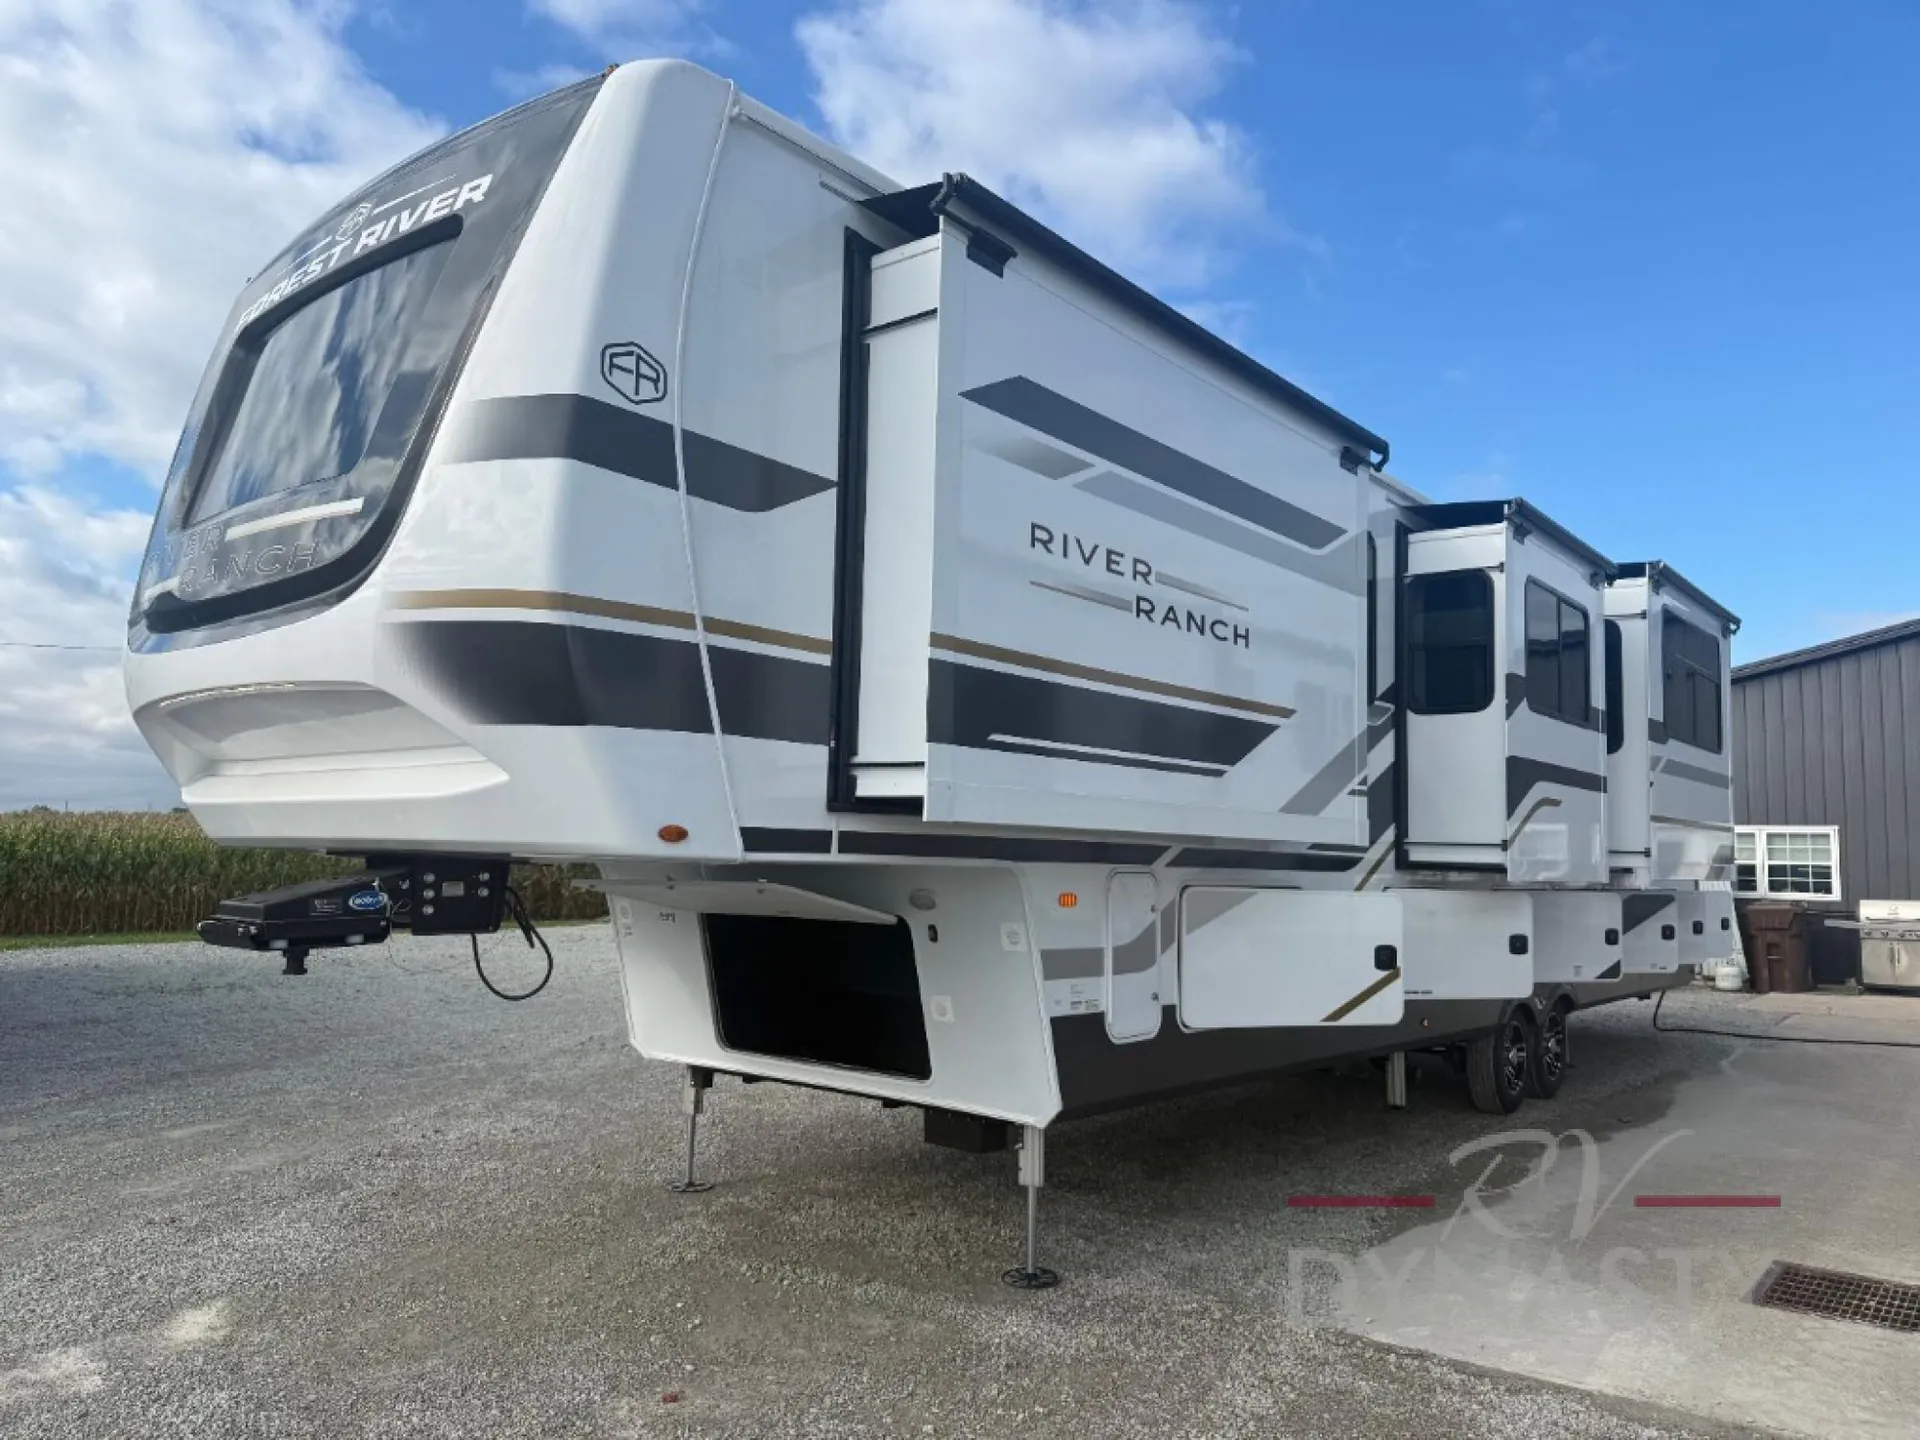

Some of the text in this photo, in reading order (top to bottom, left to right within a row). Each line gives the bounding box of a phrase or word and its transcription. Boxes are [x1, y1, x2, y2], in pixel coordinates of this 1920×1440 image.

[234, 173, 493, 332] FOREST RIVER
[608, 349, 661, 396] FR
[147, 523, 225, 567] VER
[178, 540, 323, 592] RANCH
[1030, 521, 1153, 586] RIVER
[1135, 594, 1250, 650] RANCH
